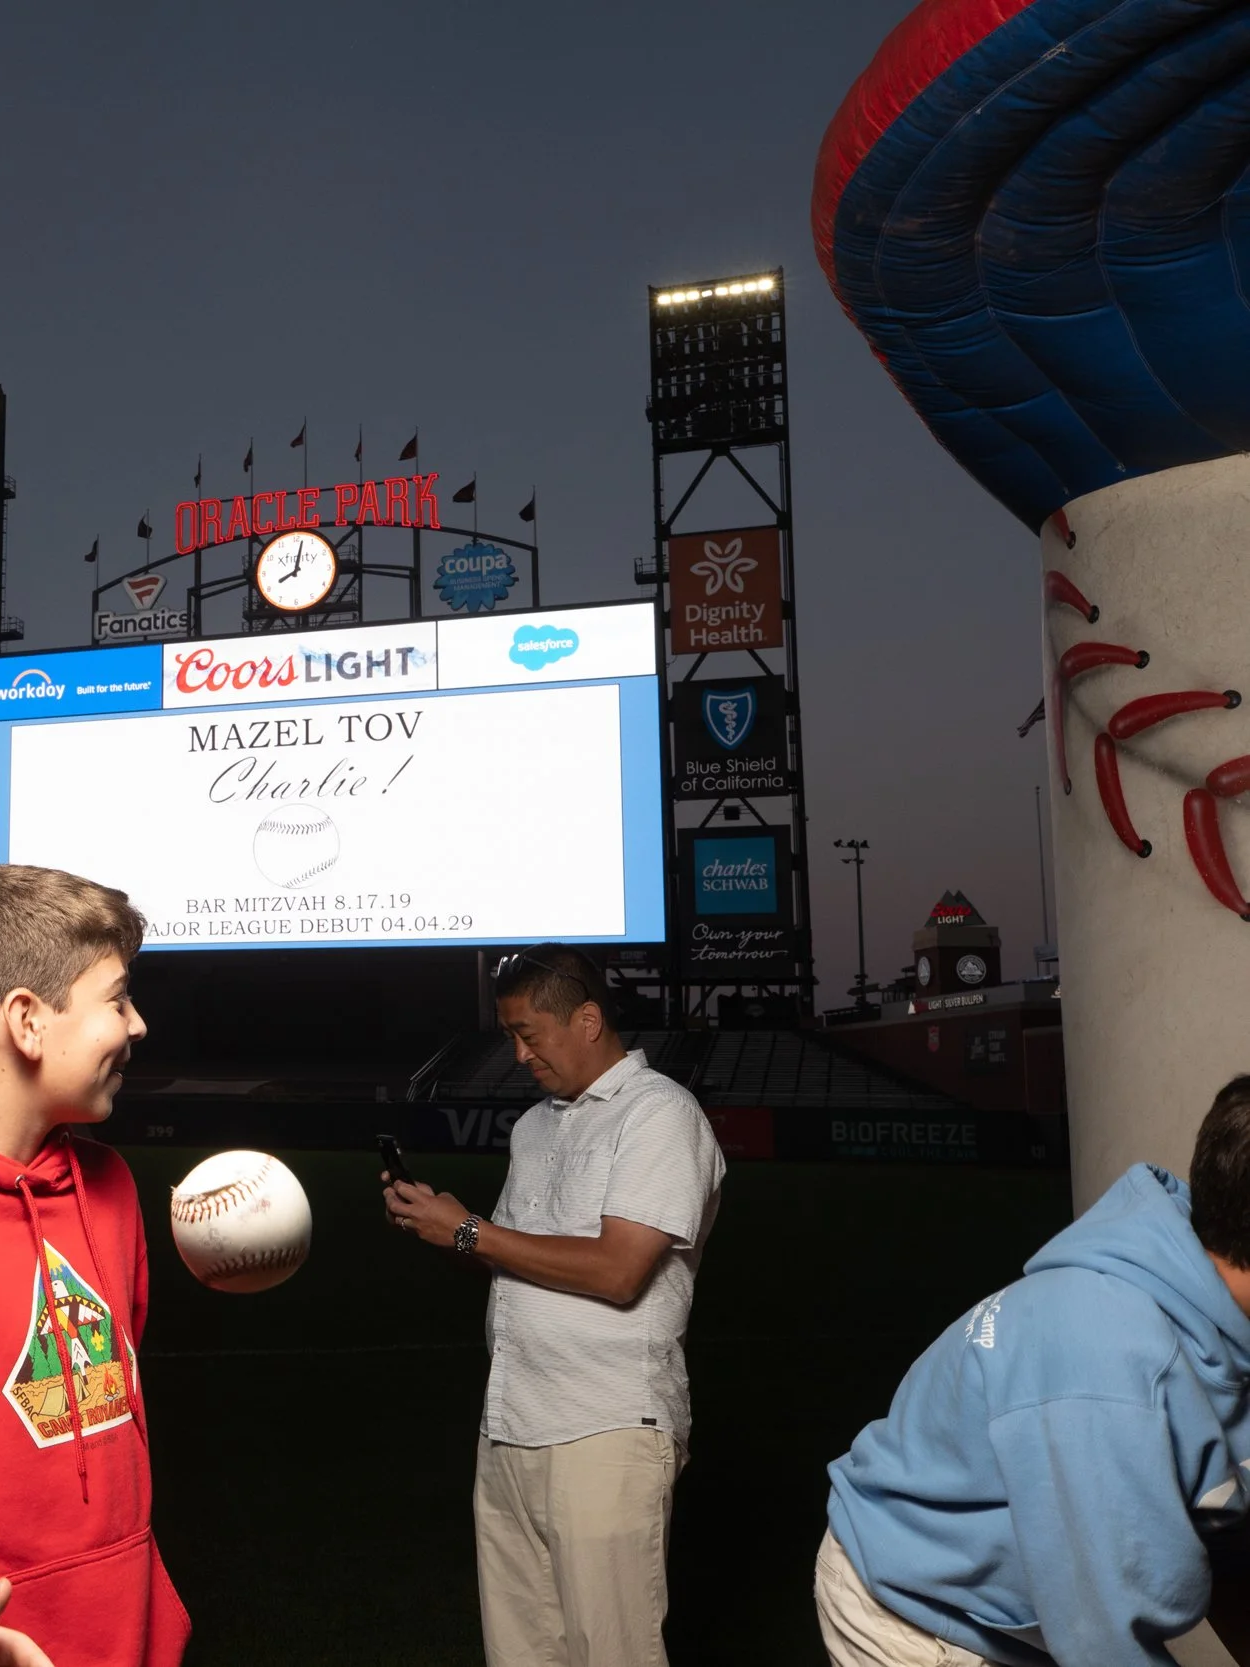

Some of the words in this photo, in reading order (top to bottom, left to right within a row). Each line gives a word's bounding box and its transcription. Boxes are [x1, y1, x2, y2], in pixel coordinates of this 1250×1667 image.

[174, 487, 320, 556] ORACLE
[334, 472, 442, 529] PARK
[445, 554, 508, 576] coupa
[97, 610, 189, 636] Fanatics
[685, 603, 766, 627] Dignity
[518, 638, 573, 652] salesforce
[690, 625, 763, 646] Health
[175, 648, 299, 694] Coors
[305, 646, 415, 683] LIGHT
[76, 686, 95, 695] Built
[96, 684, 107, 693] for
[109, 682, 123, 692] the
[188, 718, 324, 753] MAZEL
[338, 710, 424, 743] TOV
[686, 759, 721, 775] Blue
[726, 756, 777, 772] Shield
[208, 756, 367, 803] Charlie
[681, 775, 698, 792] of
[701, 773, 784, 792] California
[702, 859, 767, 878] charles
[703, 878, 769, 892] SCHWAB
[186, 898, 226, 914] BAR
[234, 896, 327, 913] MITZVAH
[334, 893, 412, 910] 8.17.19
[144, 922, 200, 937] AJOR
[209, 919, 292, 936] LEAGUE
[300, 917, 374, 934] DEBUT
[381, 915, 474, 932] 04.04.29
[937, 915, 966, 925] LIGHT
[692, 924, 733, 941] Own
[736, 929, 784, 949] your
[691, 945, 789, 961] tomorrow
[437, 1109, 520, 1147] VIS
[12, 1386, 40, 1423] SFBAC
[37, 1414, 84, 1438] CAM
